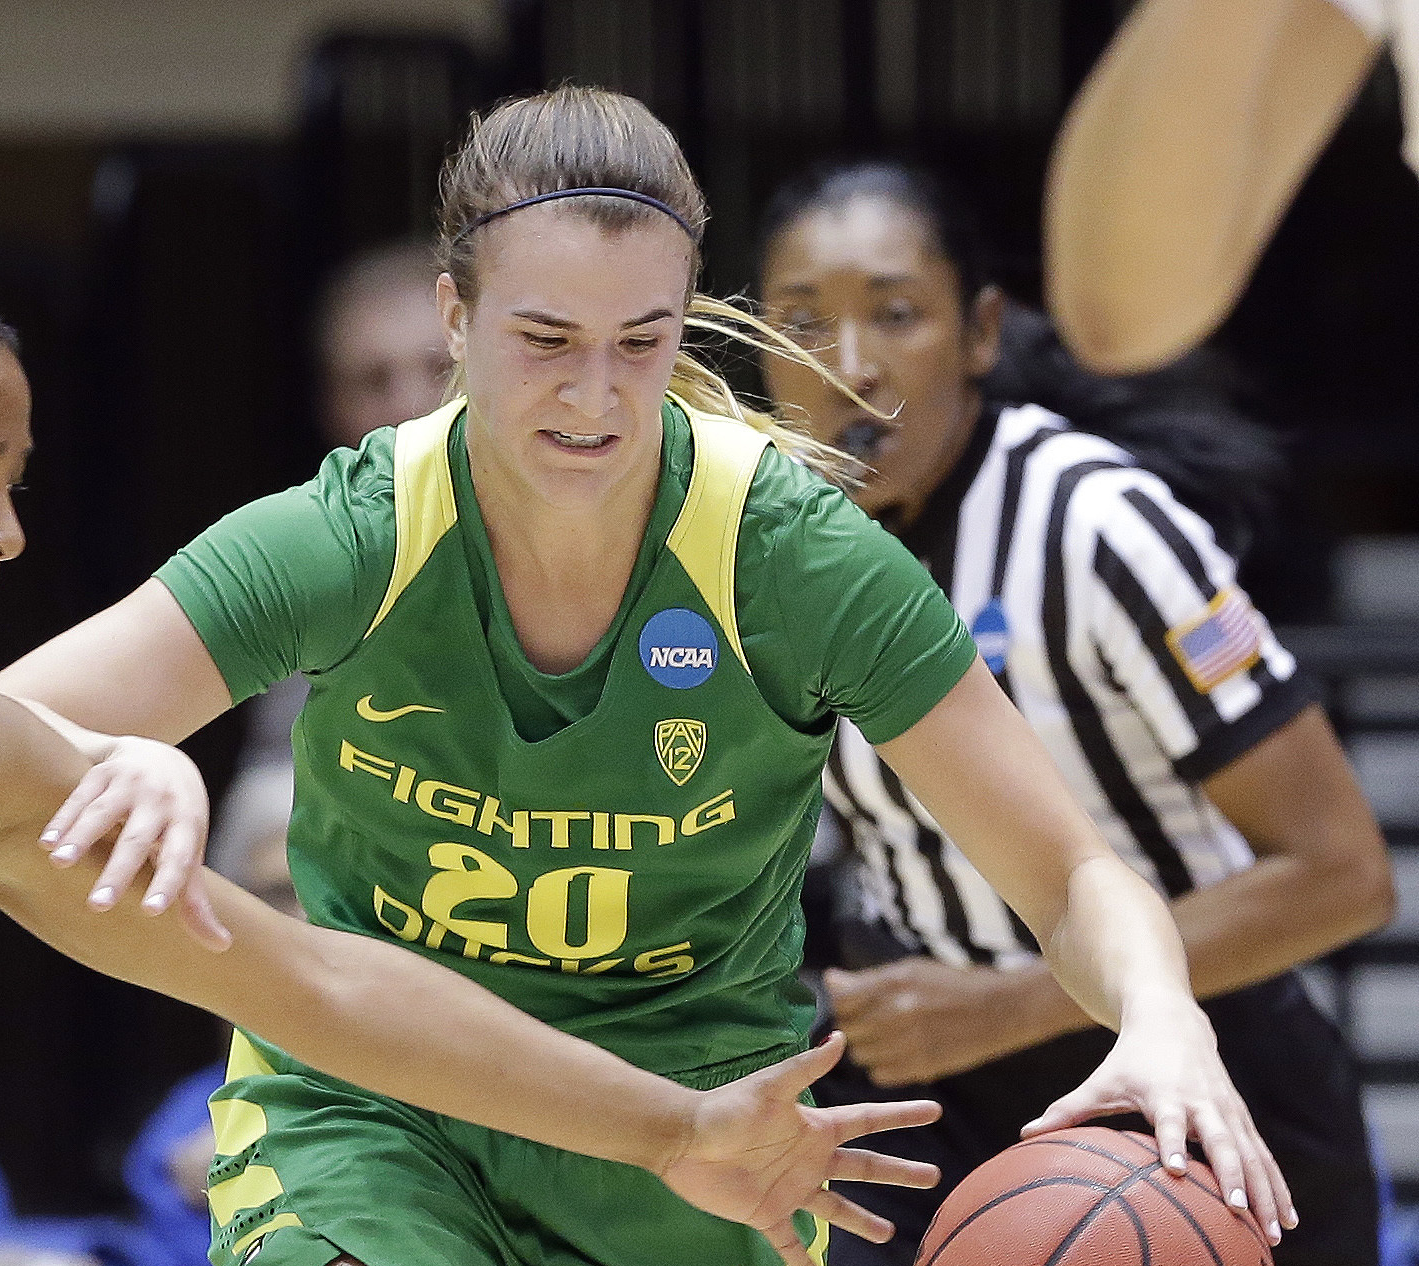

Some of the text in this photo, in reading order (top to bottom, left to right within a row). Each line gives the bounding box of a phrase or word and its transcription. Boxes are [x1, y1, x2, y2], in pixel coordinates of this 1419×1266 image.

[650, 646, 713, 668] NCAA
[667, 746, 692, 770] 12
[339, 739, 735, 849] FIGHTING
[421, 841, 634, 960] 20
